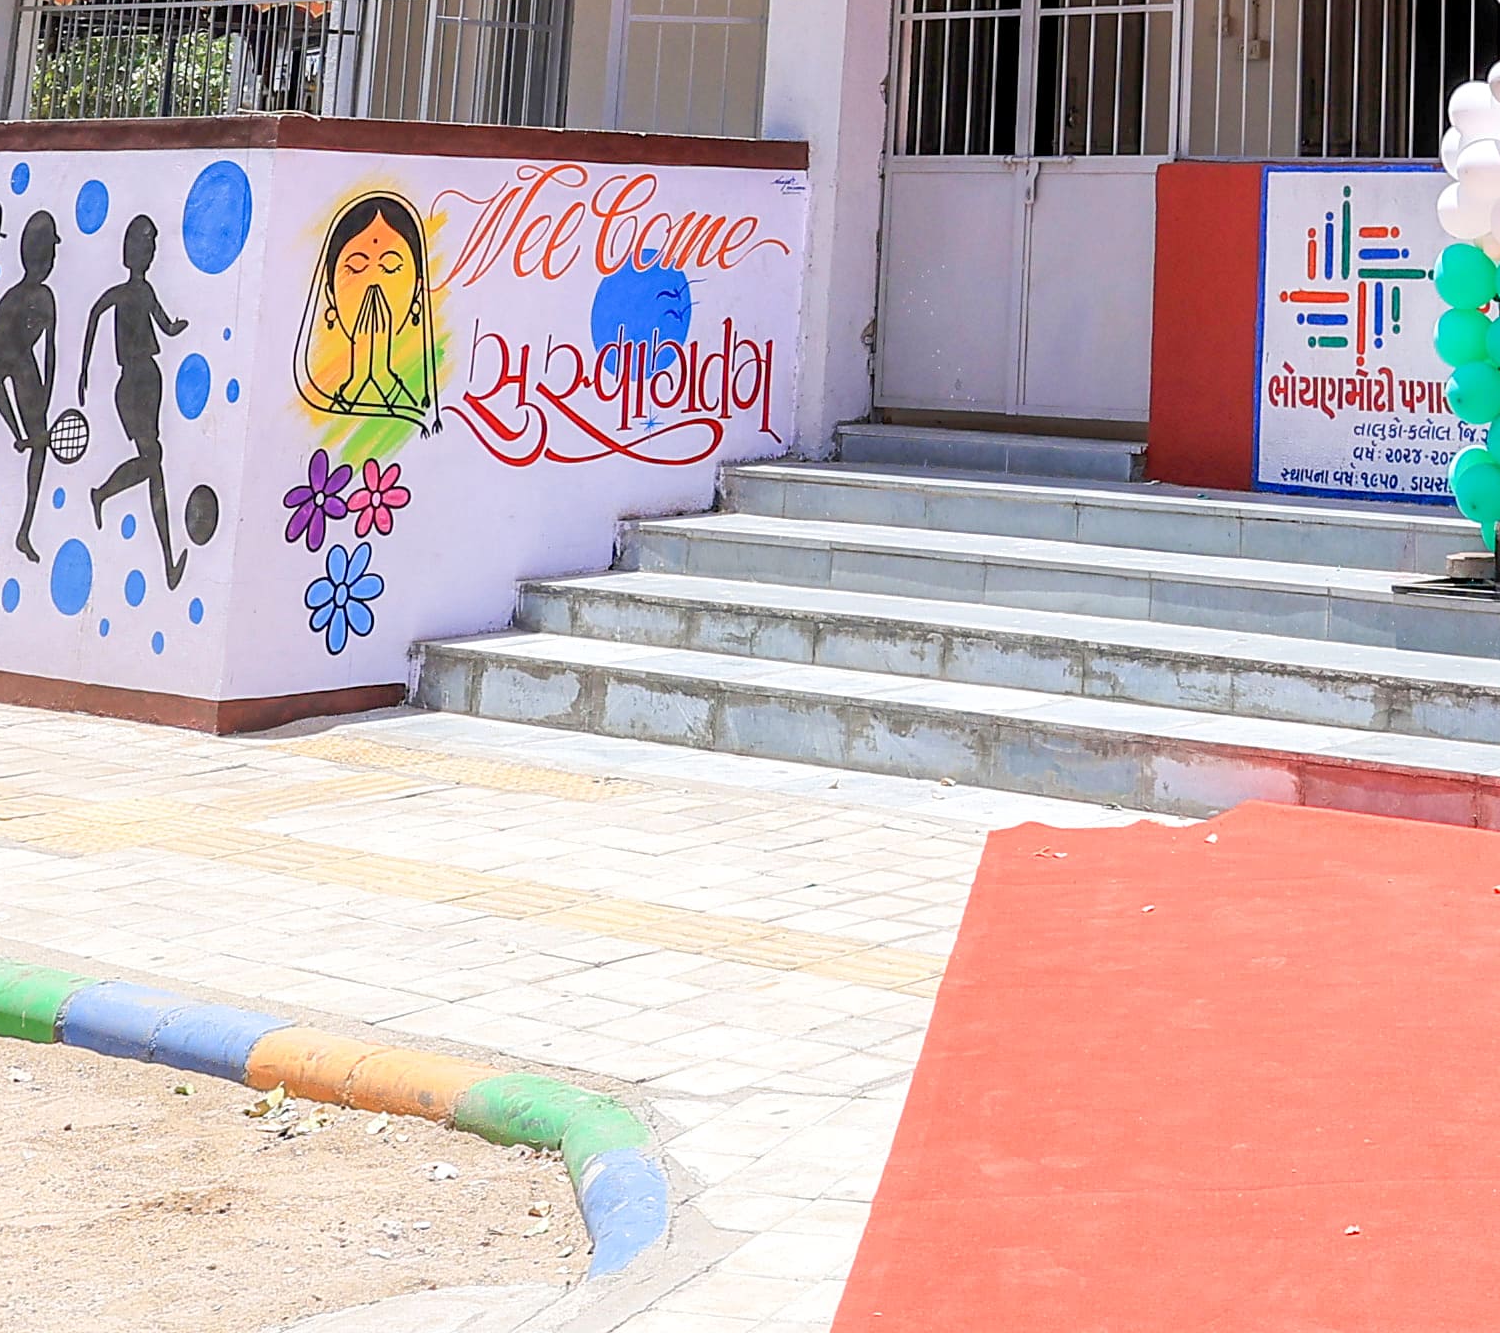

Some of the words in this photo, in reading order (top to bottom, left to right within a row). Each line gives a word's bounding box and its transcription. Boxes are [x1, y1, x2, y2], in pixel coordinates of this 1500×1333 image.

[591, 174, 790, 276] Come
[1269, 362, 1395, 420] ભોયણમોટી
[1280, 466, 1329, 485] સ્થાપના
